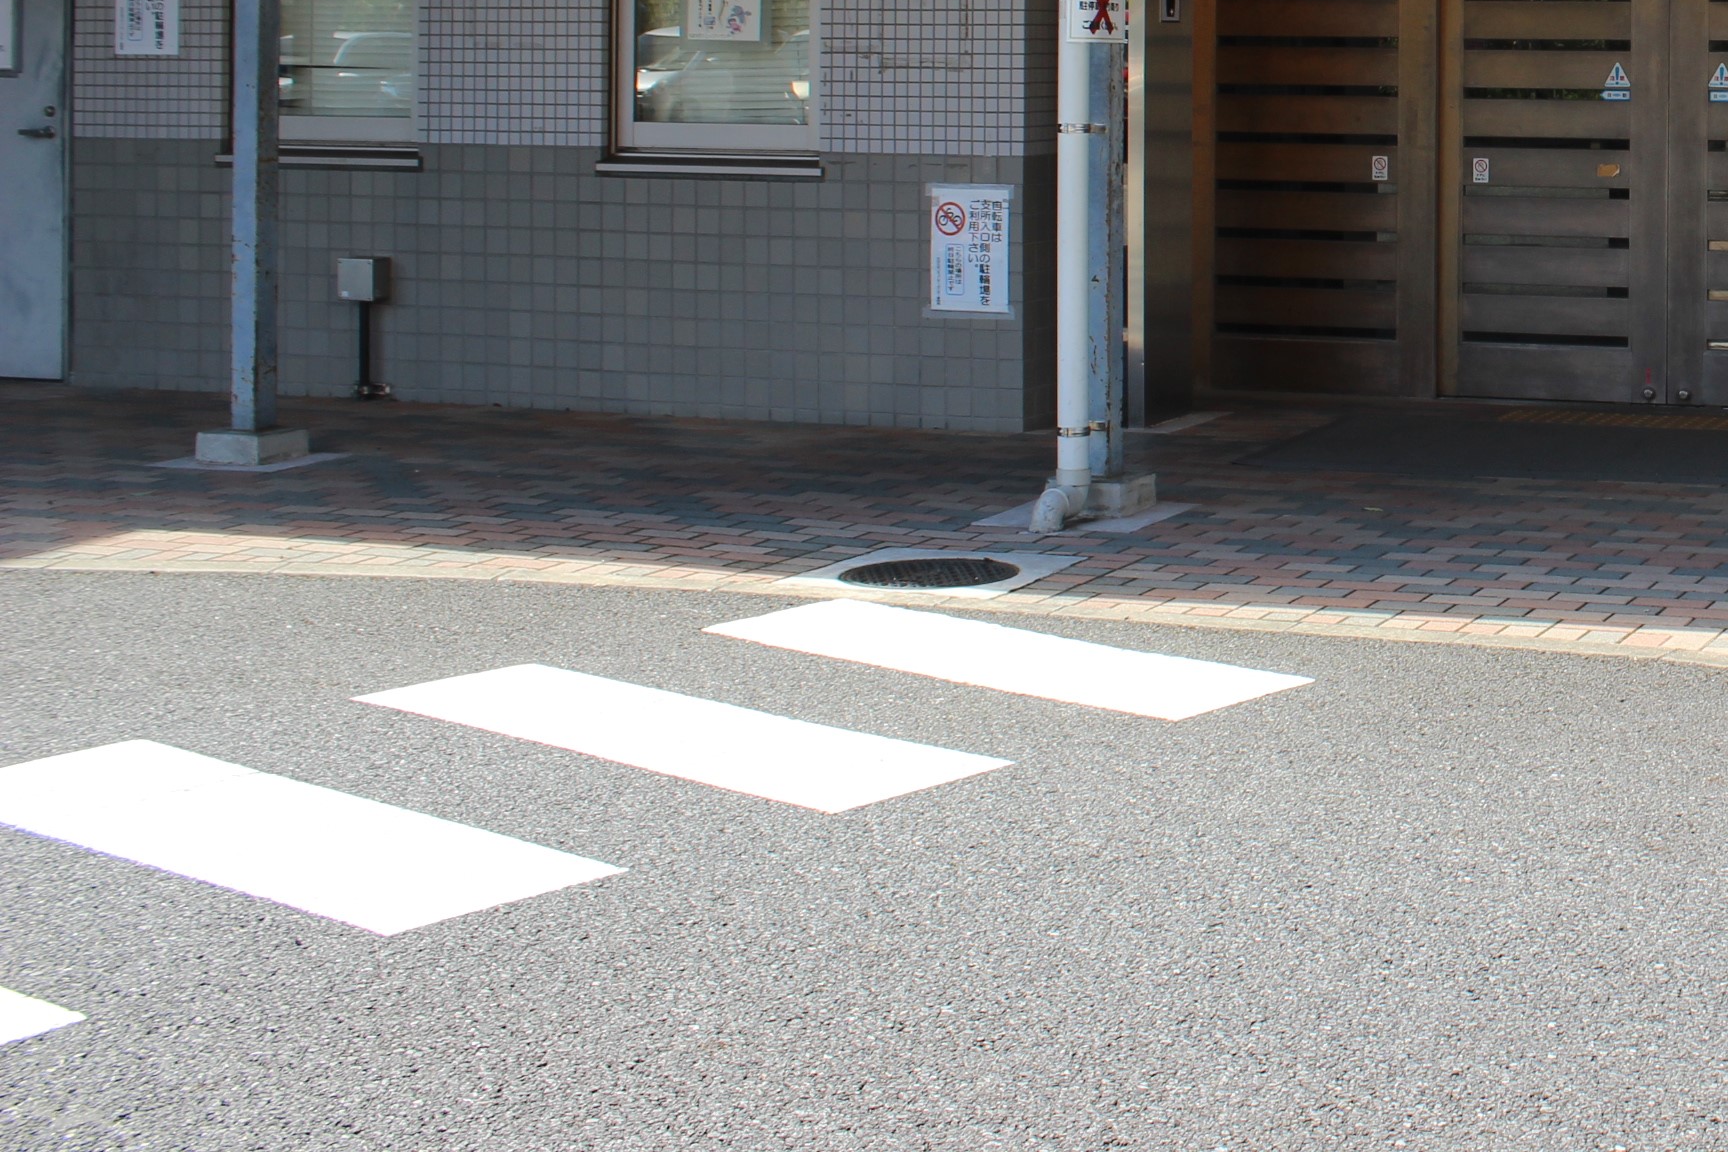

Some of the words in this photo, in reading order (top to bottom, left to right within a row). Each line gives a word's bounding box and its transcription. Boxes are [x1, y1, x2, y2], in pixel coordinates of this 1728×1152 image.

[968, 200, 980, 268] ご利用下さい。
[979, 200, 991, 306] 支所入口側の駐輪場を
[991, 201, 1002, 242] 自転車は
